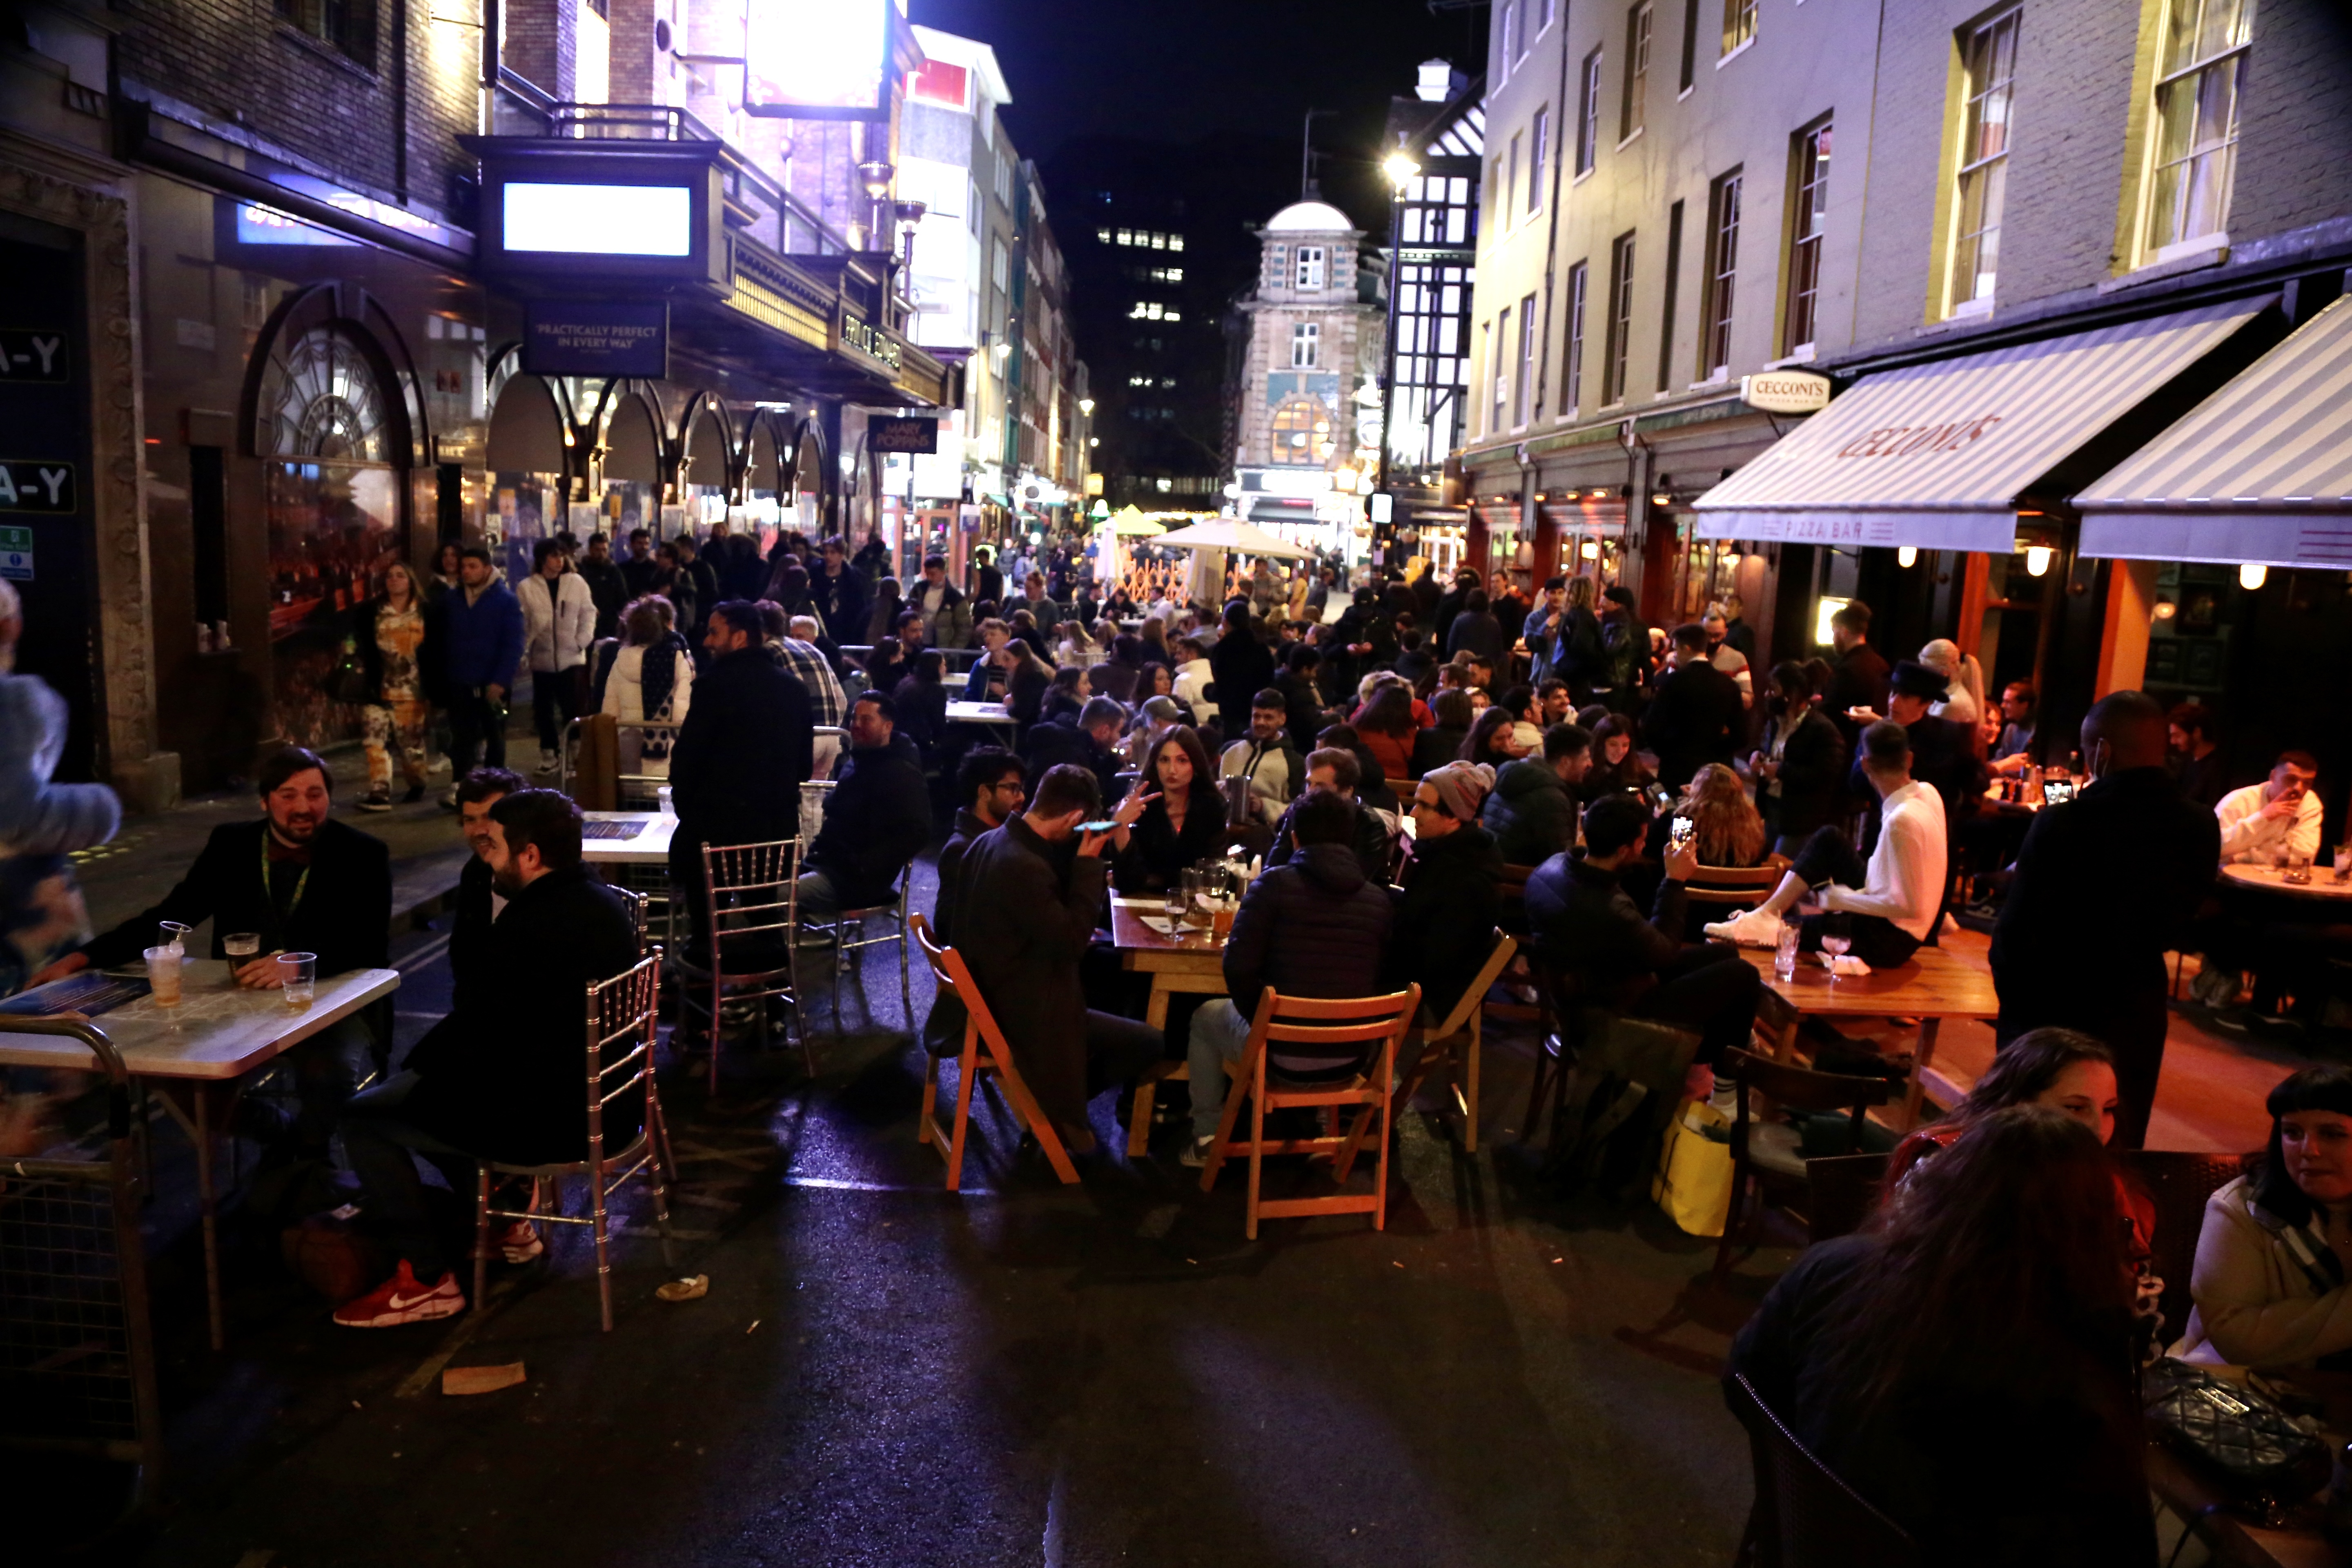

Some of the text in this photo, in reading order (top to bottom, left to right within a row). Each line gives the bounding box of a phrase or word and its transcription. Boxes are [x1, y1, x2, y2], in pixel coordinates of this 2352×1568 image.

[611, 326, 657, 337] PERFECT
[558, 337, 570, 347] IN
[572, 337, 607, 348] EVERY
[1756, 380, 1824, 396] CECCONI'S
[885, 422, 922, 436] MARY
